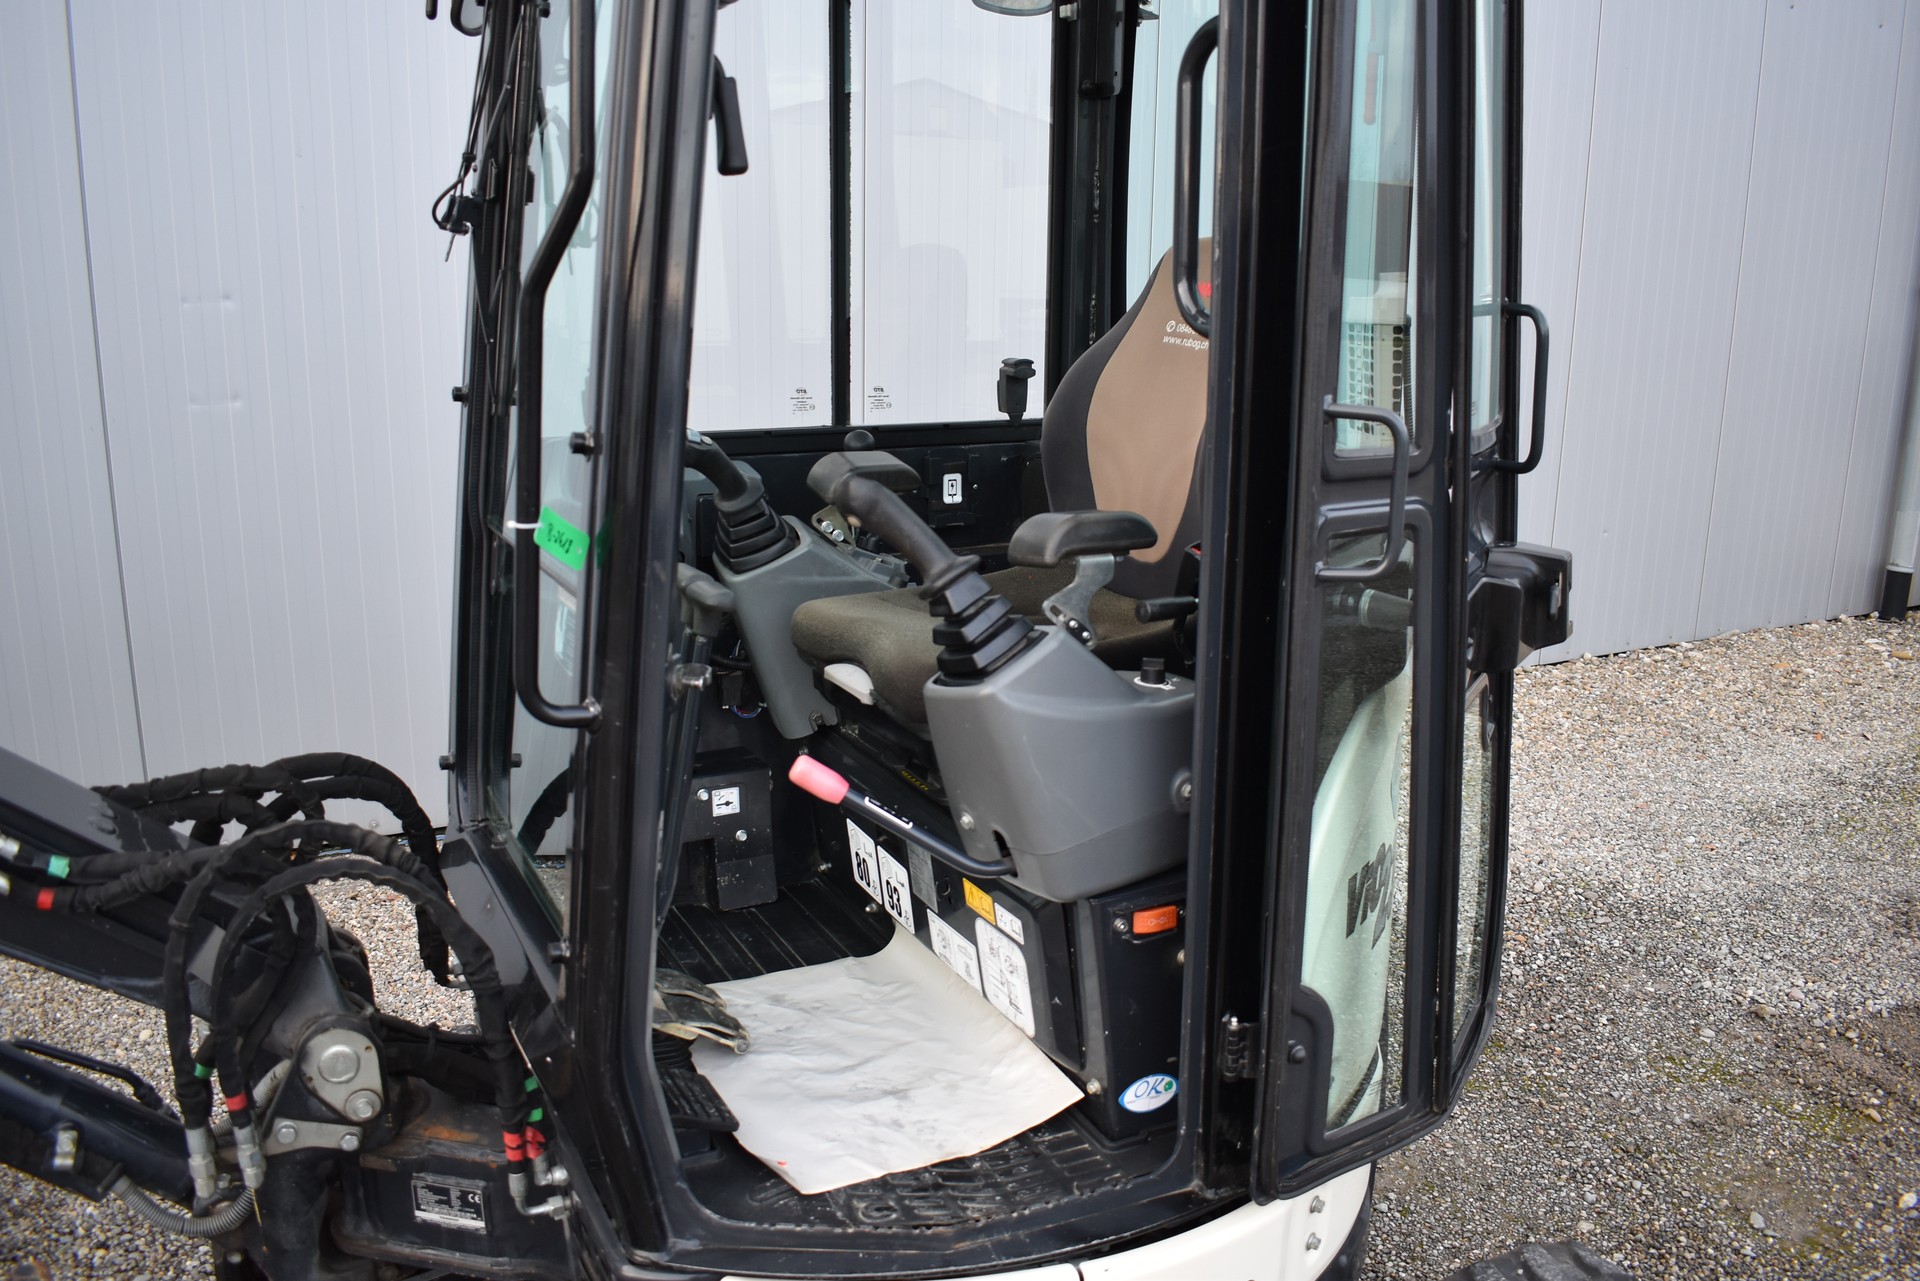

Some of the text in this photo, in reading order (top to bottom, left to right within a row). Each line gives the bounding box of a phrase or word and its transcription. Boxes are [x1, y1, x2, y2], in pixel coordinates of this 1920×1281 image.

[855, 850, 871, 888] 80
[885, 879, 902, 918] 93
[1134, 1077, 1165, 1098] OK
[467, 1193, 481, 1203] CE
